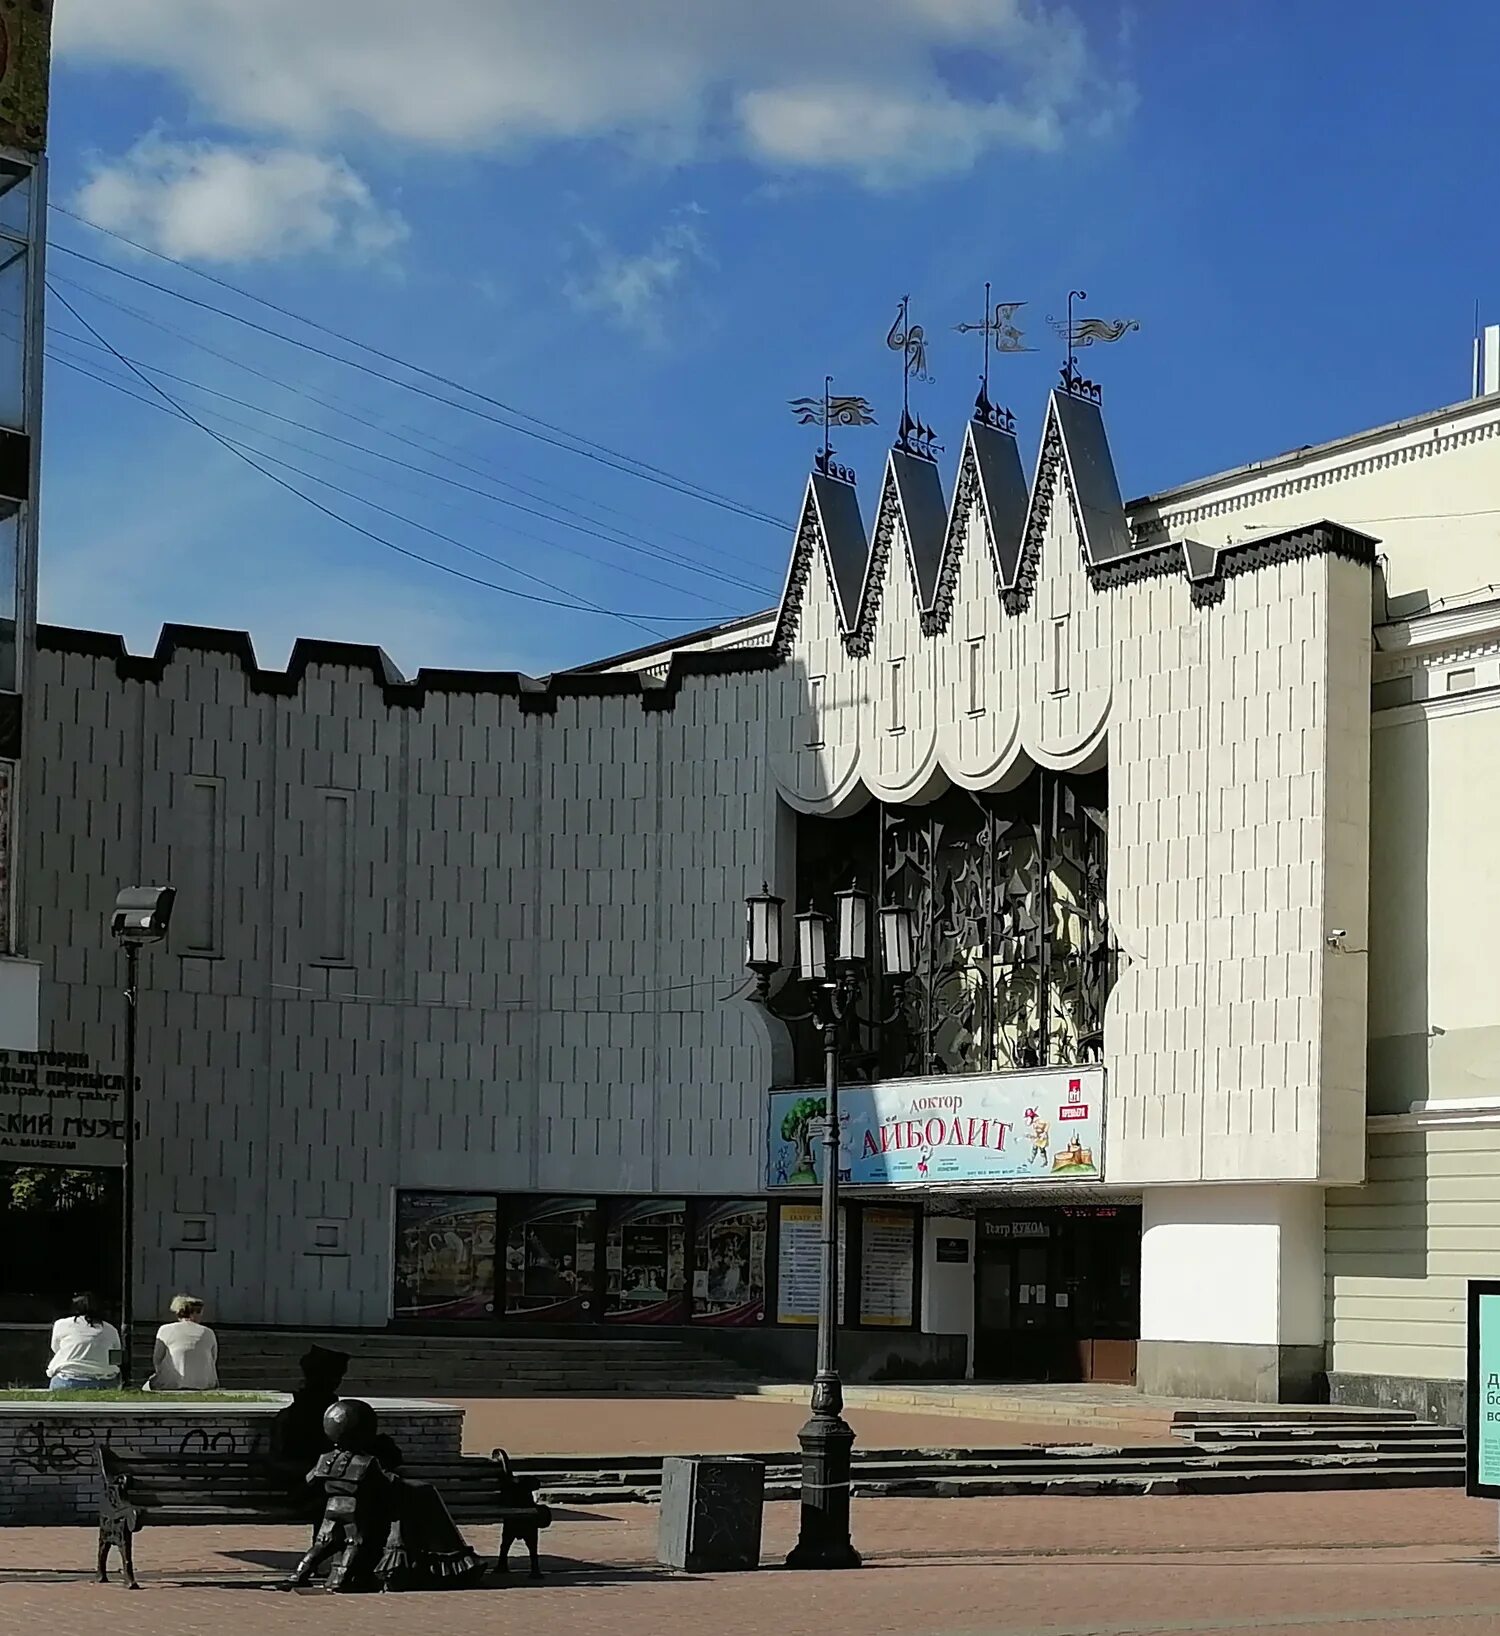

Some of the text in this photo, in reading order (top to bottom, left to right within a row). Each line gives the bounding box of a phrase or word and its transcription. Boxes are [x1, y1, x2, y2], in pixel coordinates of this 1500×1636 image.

[46, 1071, 141, 1091] ПРОМЫСЛВ
[20, 1138, 76, 1149] MUSEUM
[860, 1115, 1014, 1161] АЙБОЛИТ
